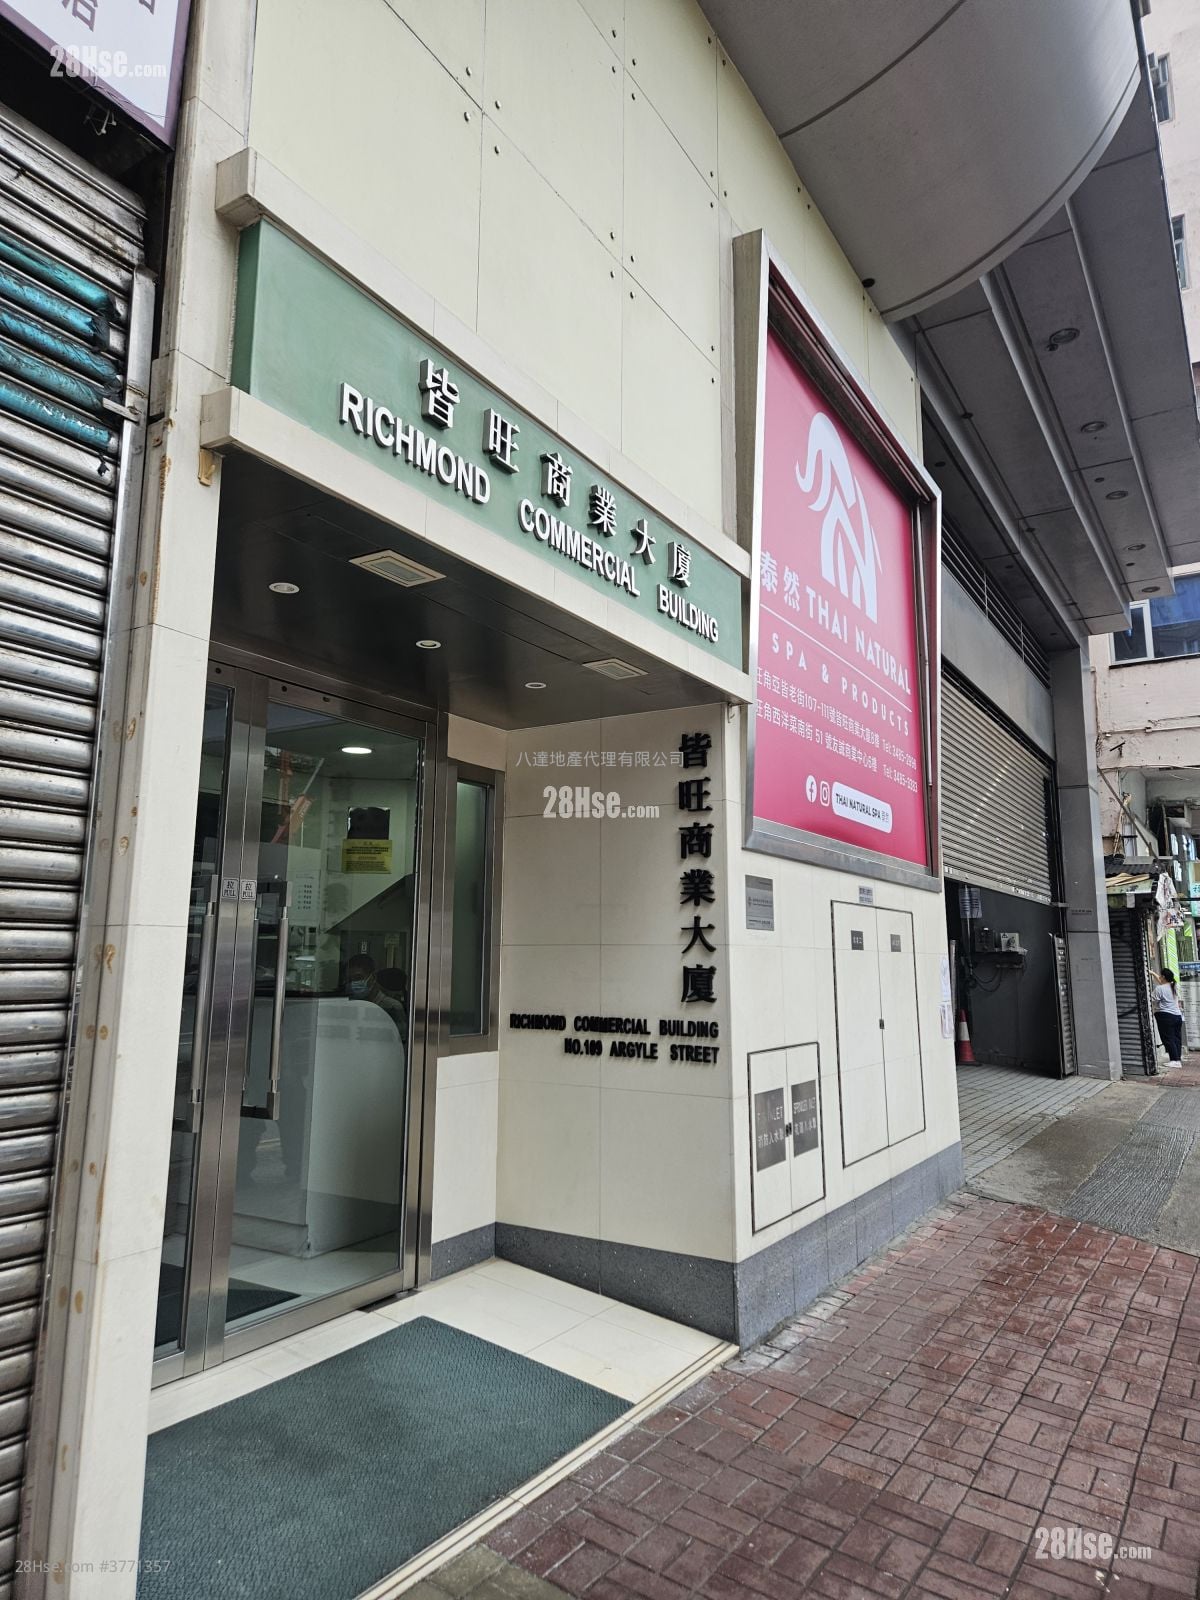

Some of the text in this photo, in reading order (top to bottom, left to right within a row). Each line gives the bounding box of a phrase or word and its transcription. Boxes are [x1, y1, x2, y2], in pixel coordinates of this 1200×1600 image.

[339, 382, 719, 643] RICHMOND COMMERCIAL BUILDING
[419, 359, 692, 588] 皆旺商業大廈
[759, 550, 911, 695] 泰然 THAI NATURAL
[771, 632, 909, 736] SPA & PRODUCTS
[678, 732, 718, 1003] 皆旺商業大廈
[836, 793, 849, 806] THAI
[849, 799, 871, 816] NATURAL
[872, 807, 881, 819] SPA
[510, 1013, 719, 1038] RICHMOND COMMERCIAL BUILDING
[609, 1041, 658, 1059] ARGYLE
[670, 1044, 720, 1064] STREET
